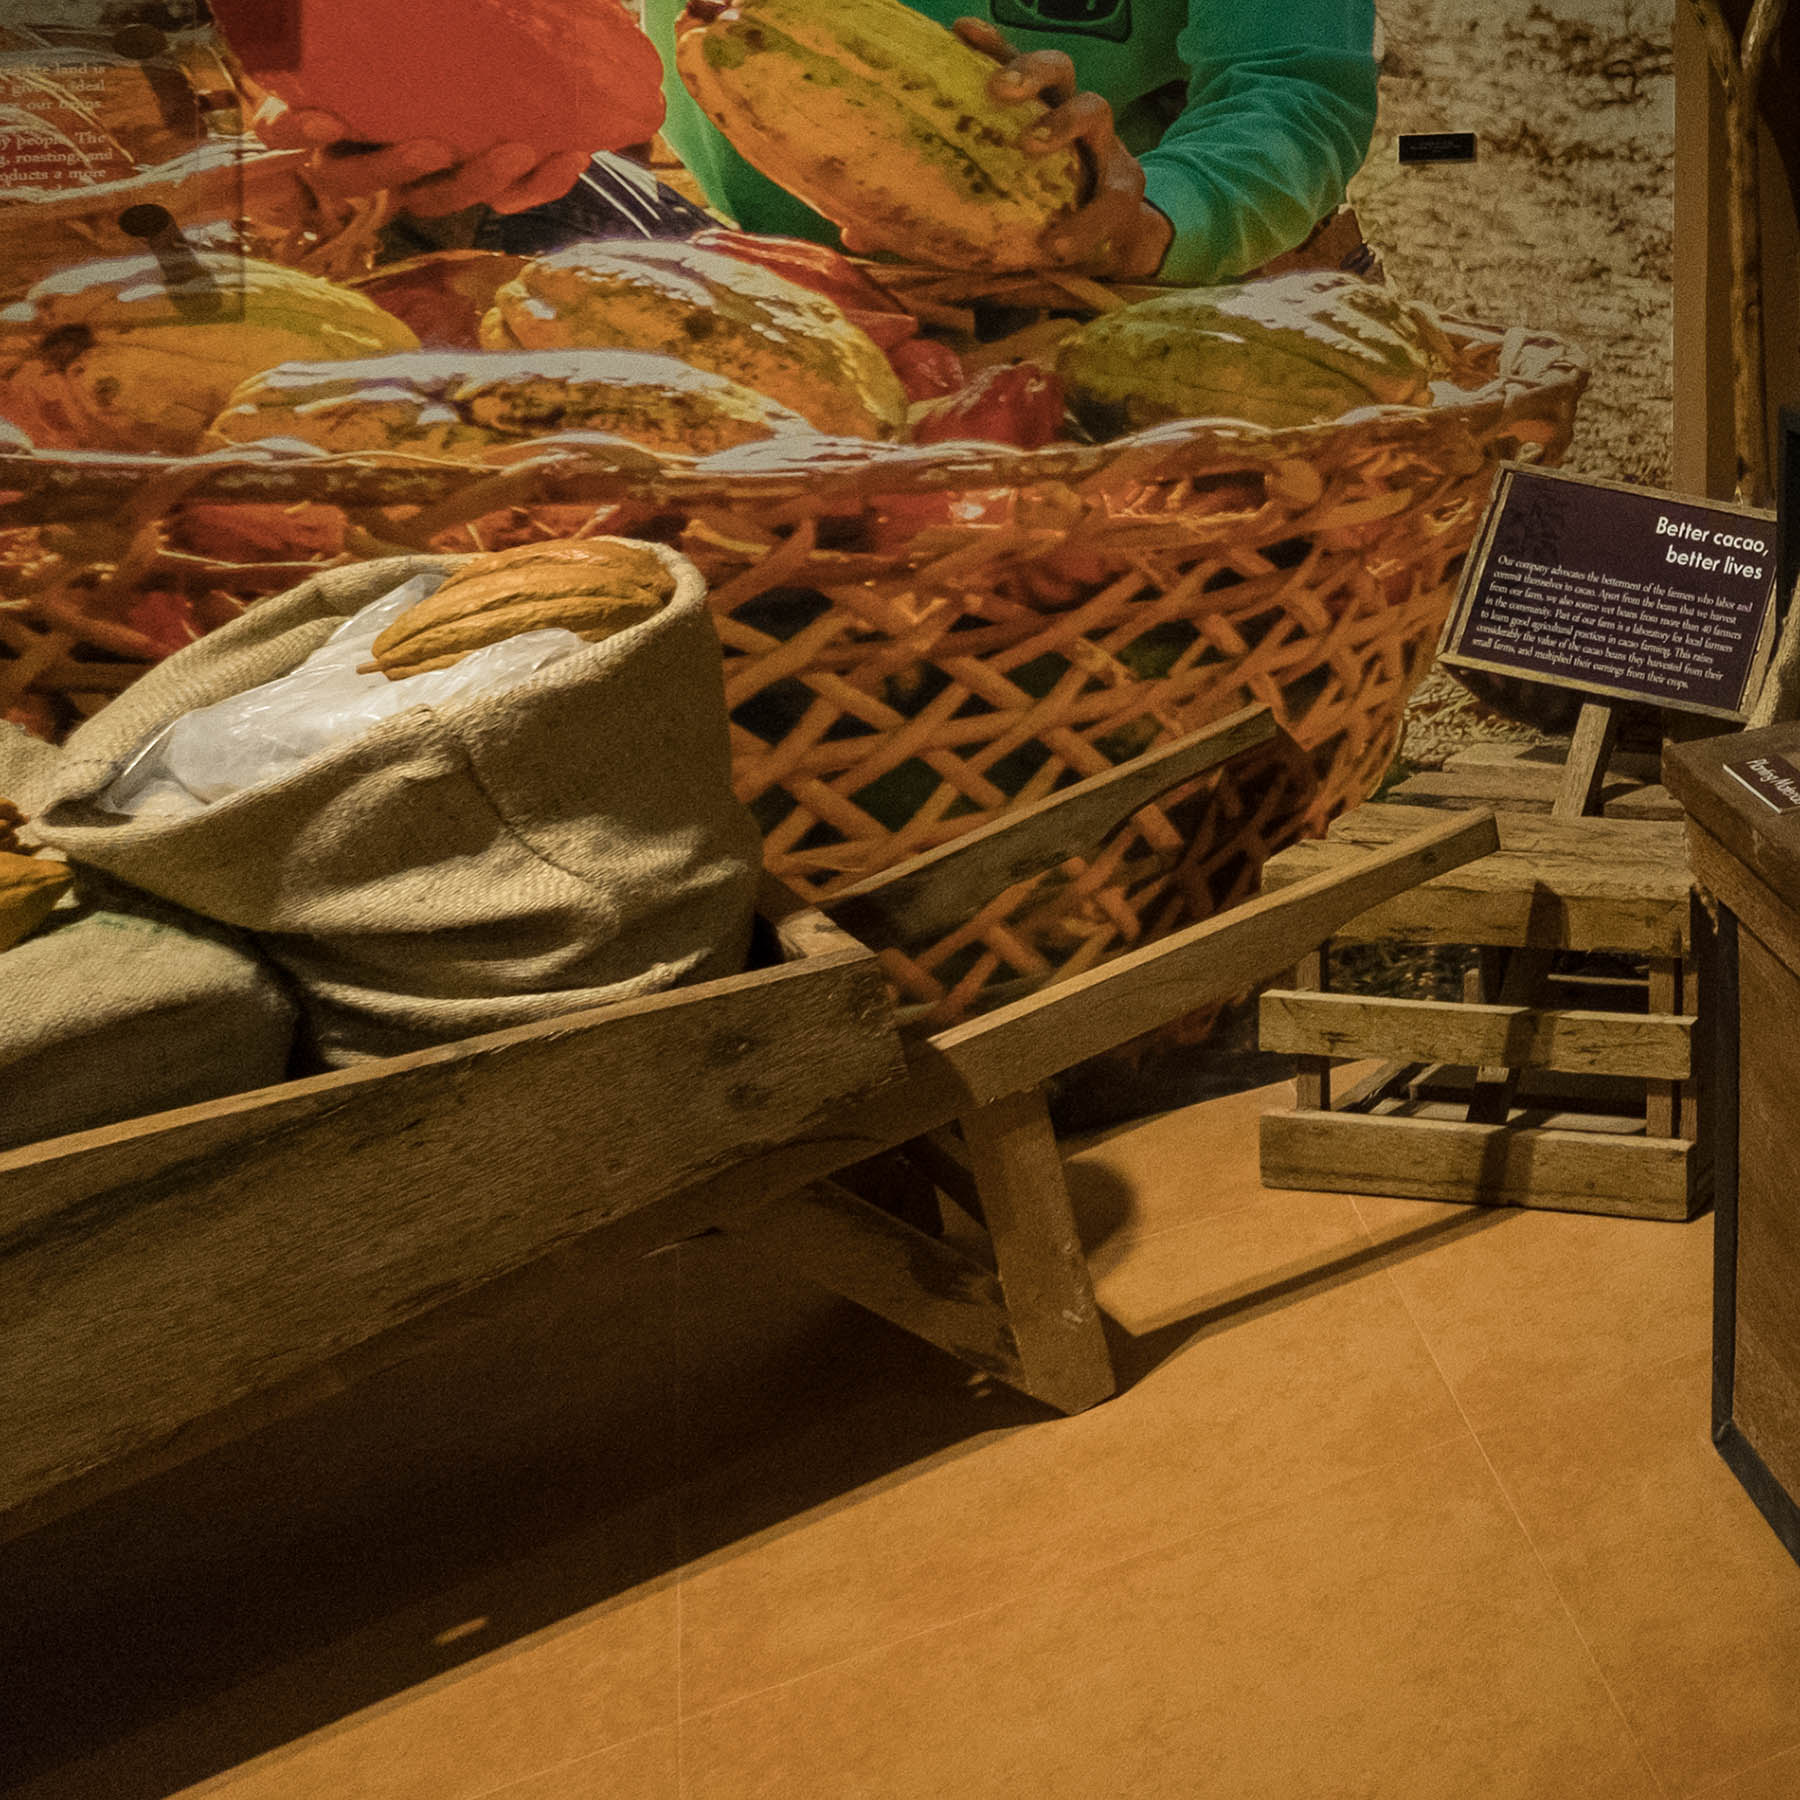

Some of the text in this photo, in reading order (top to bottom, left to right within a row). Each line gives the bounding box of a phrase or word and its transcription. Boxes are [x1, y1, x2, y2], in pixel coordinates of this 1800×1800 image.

[1655, 515, 1770, 557] Better cacao,
[1665, 544, 1764, 581] better lives
